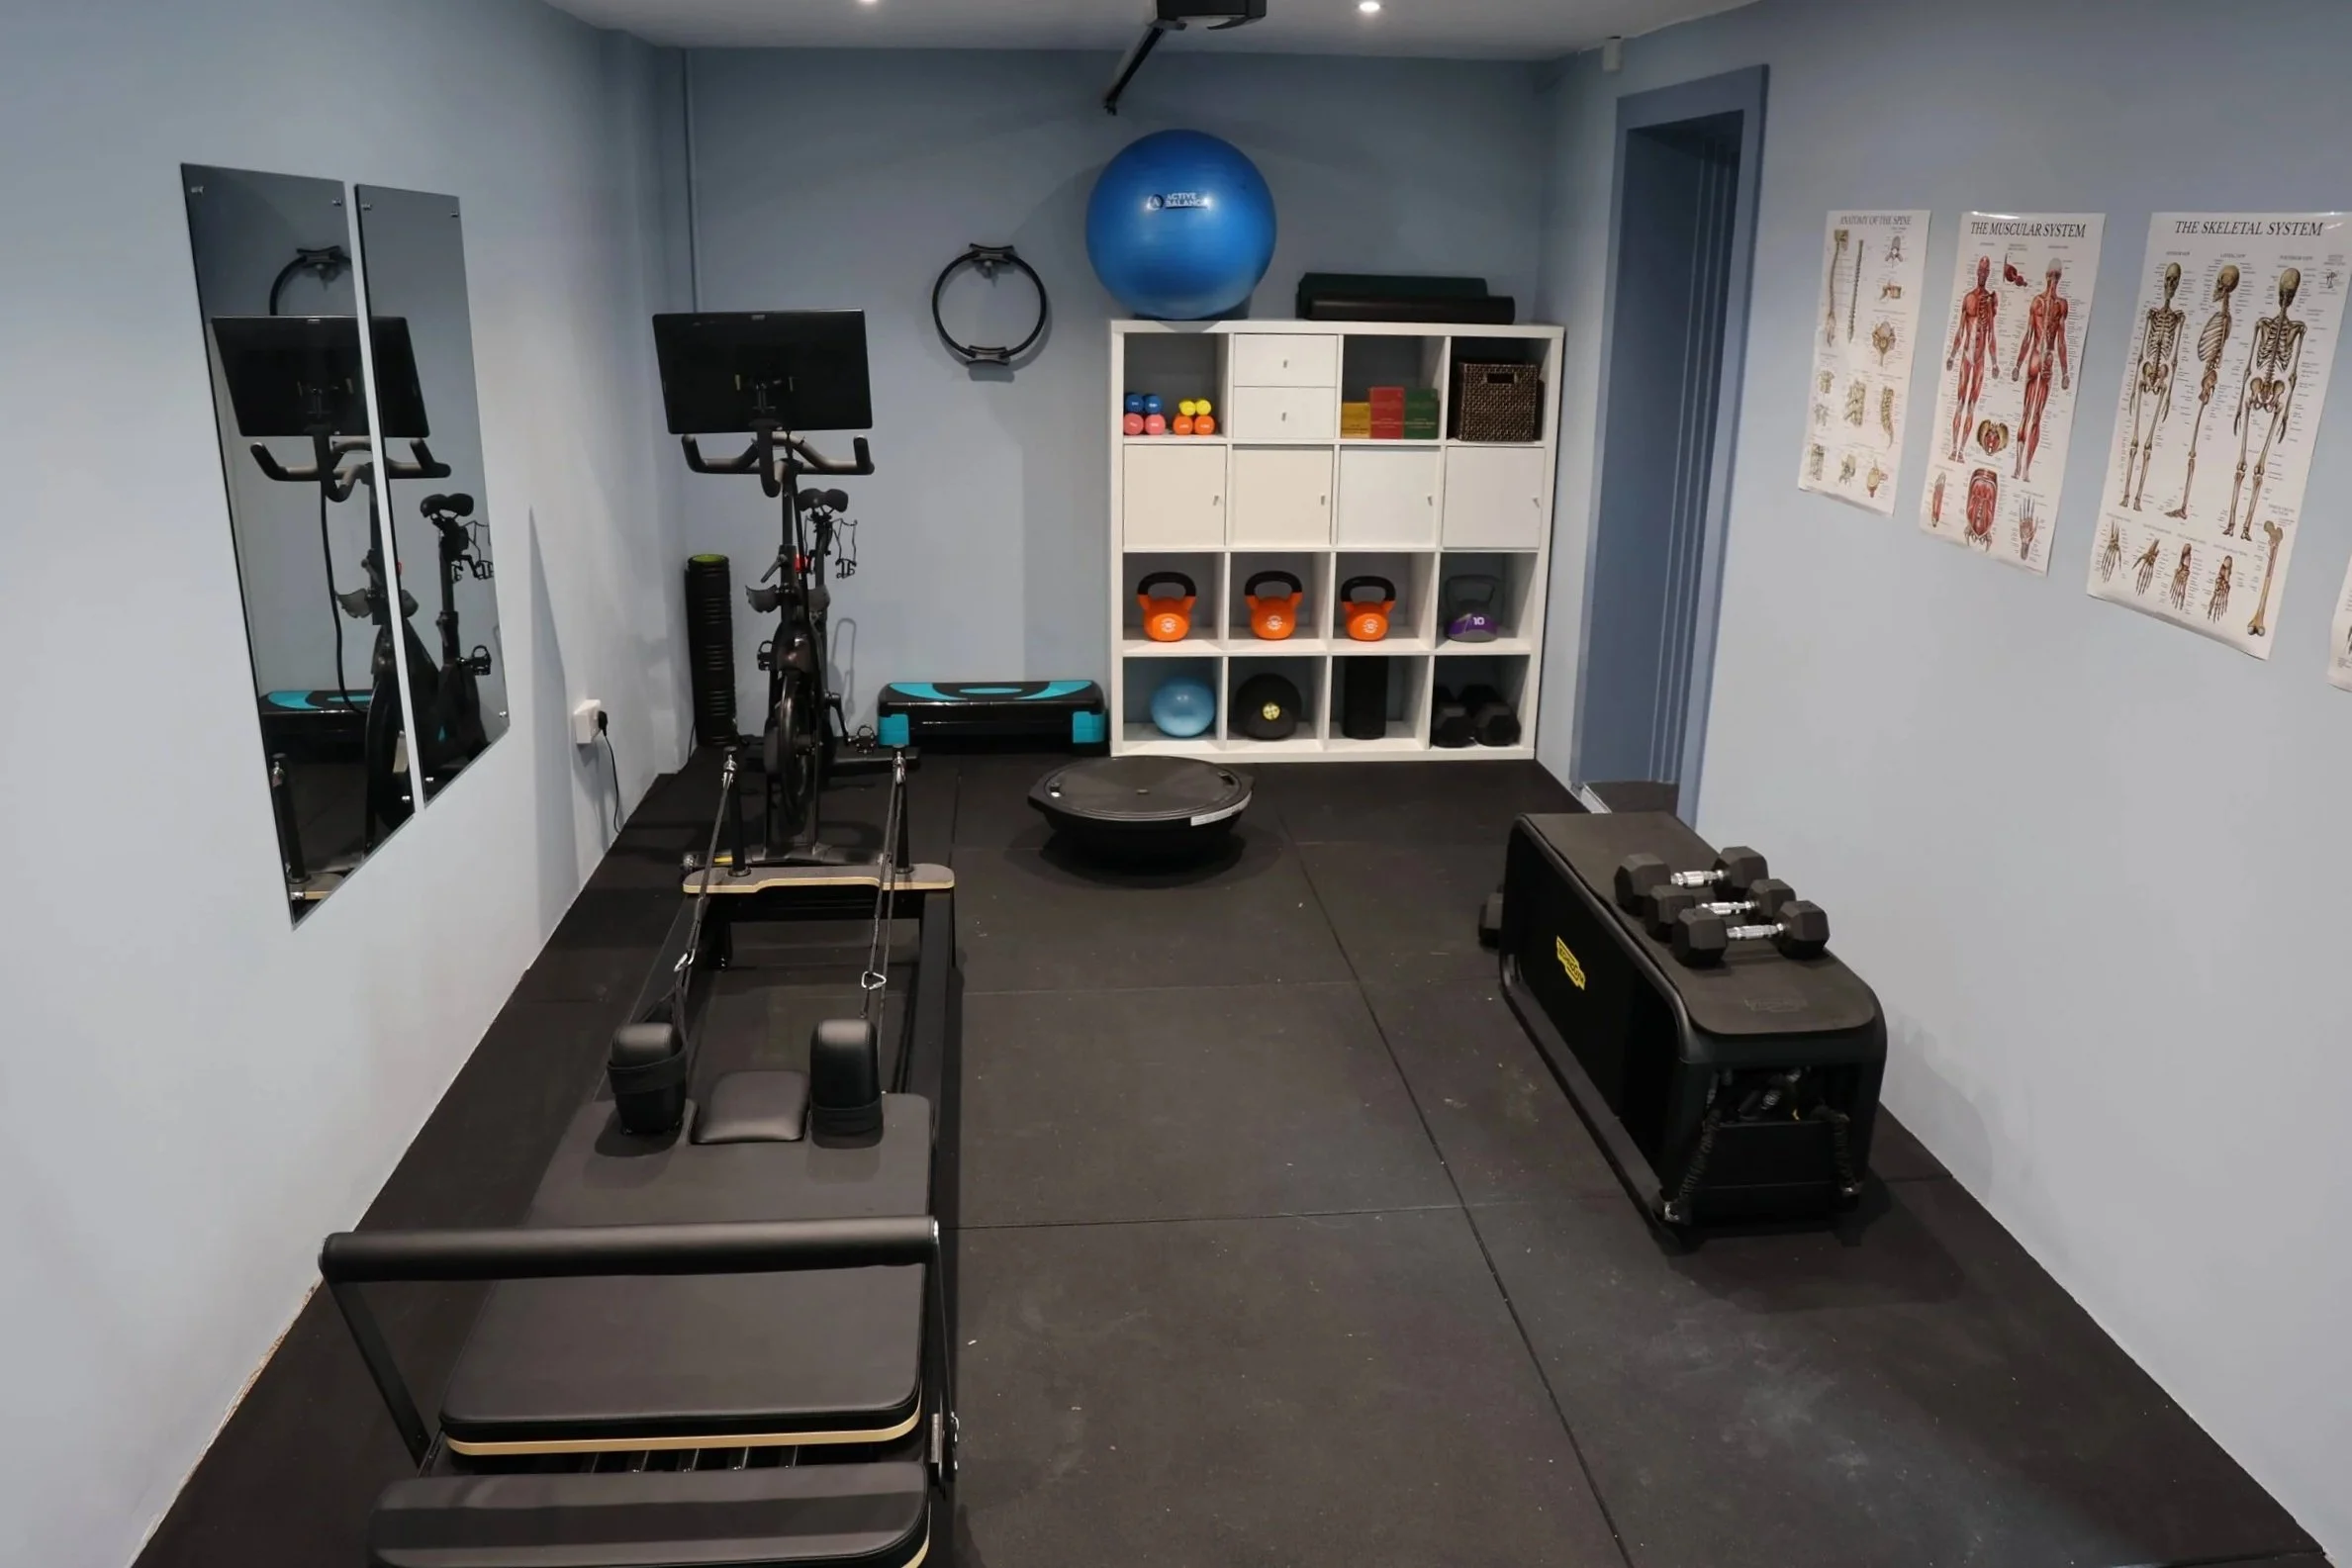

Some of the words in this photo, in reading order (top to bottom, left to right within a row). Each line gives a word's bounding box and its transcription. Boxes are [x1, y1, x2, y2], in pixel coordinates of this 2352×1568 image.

[1893, 216, 1913, 226] SPINE
[1971, 222, 1990, 235] THE
[1989, 222, 2042, 236] MUSCULAR
[2042, 224, 2087, 238] SYSTEM
[2175, 221, 2200, 233] THE
[2201, 221, 2264, 235] SKELETAL
[2266, 222, 2323, 236] SYSTEM
[1472, 616, 1485, 626] 10
